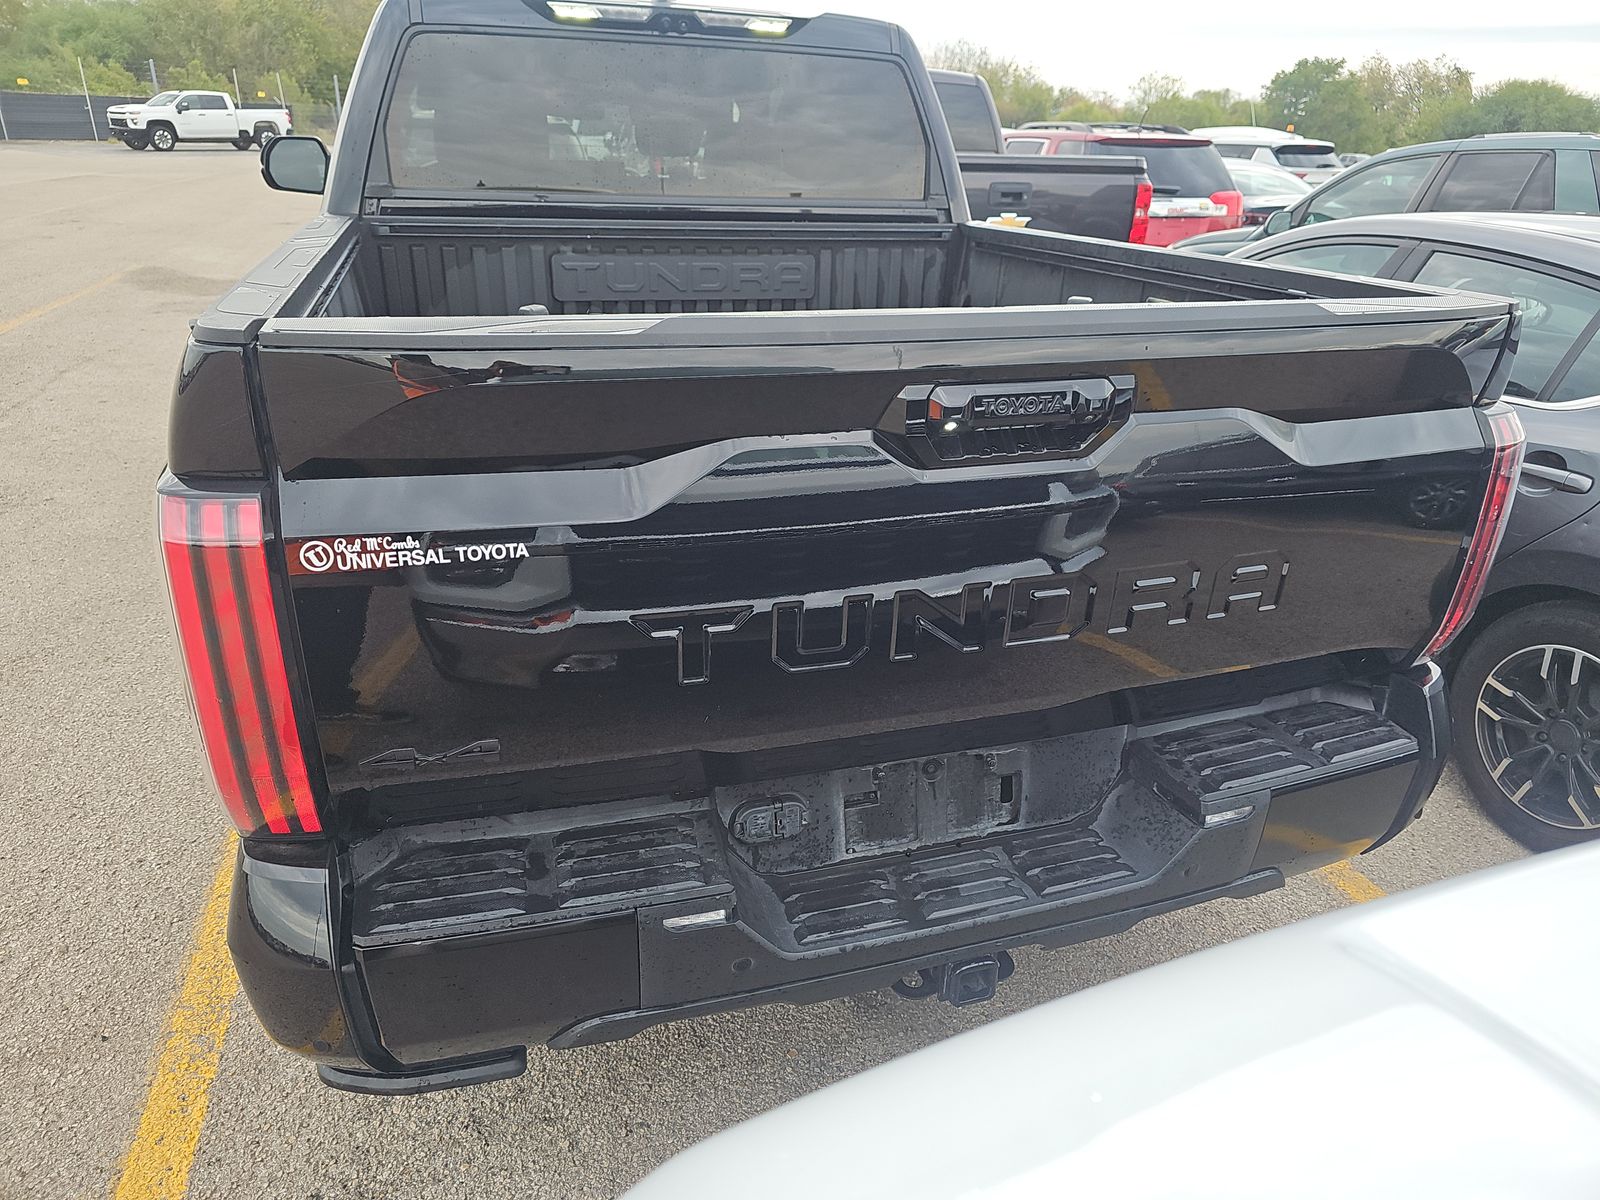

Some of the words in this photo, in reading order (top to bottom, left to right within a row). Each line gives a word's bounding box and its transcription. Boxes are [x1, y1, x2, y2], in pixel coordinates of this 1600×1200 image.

[561, 261, 808, 293] TUNDRA
[981, 395, 1067, 417] TOYOTA
[334, 537, 361, 554] Red
[336, 549, 451, 570] UNIVERSAL
[455, 543, 530, 563] TOYOTA
[628, 549, 1291, 686] TUNDRA
